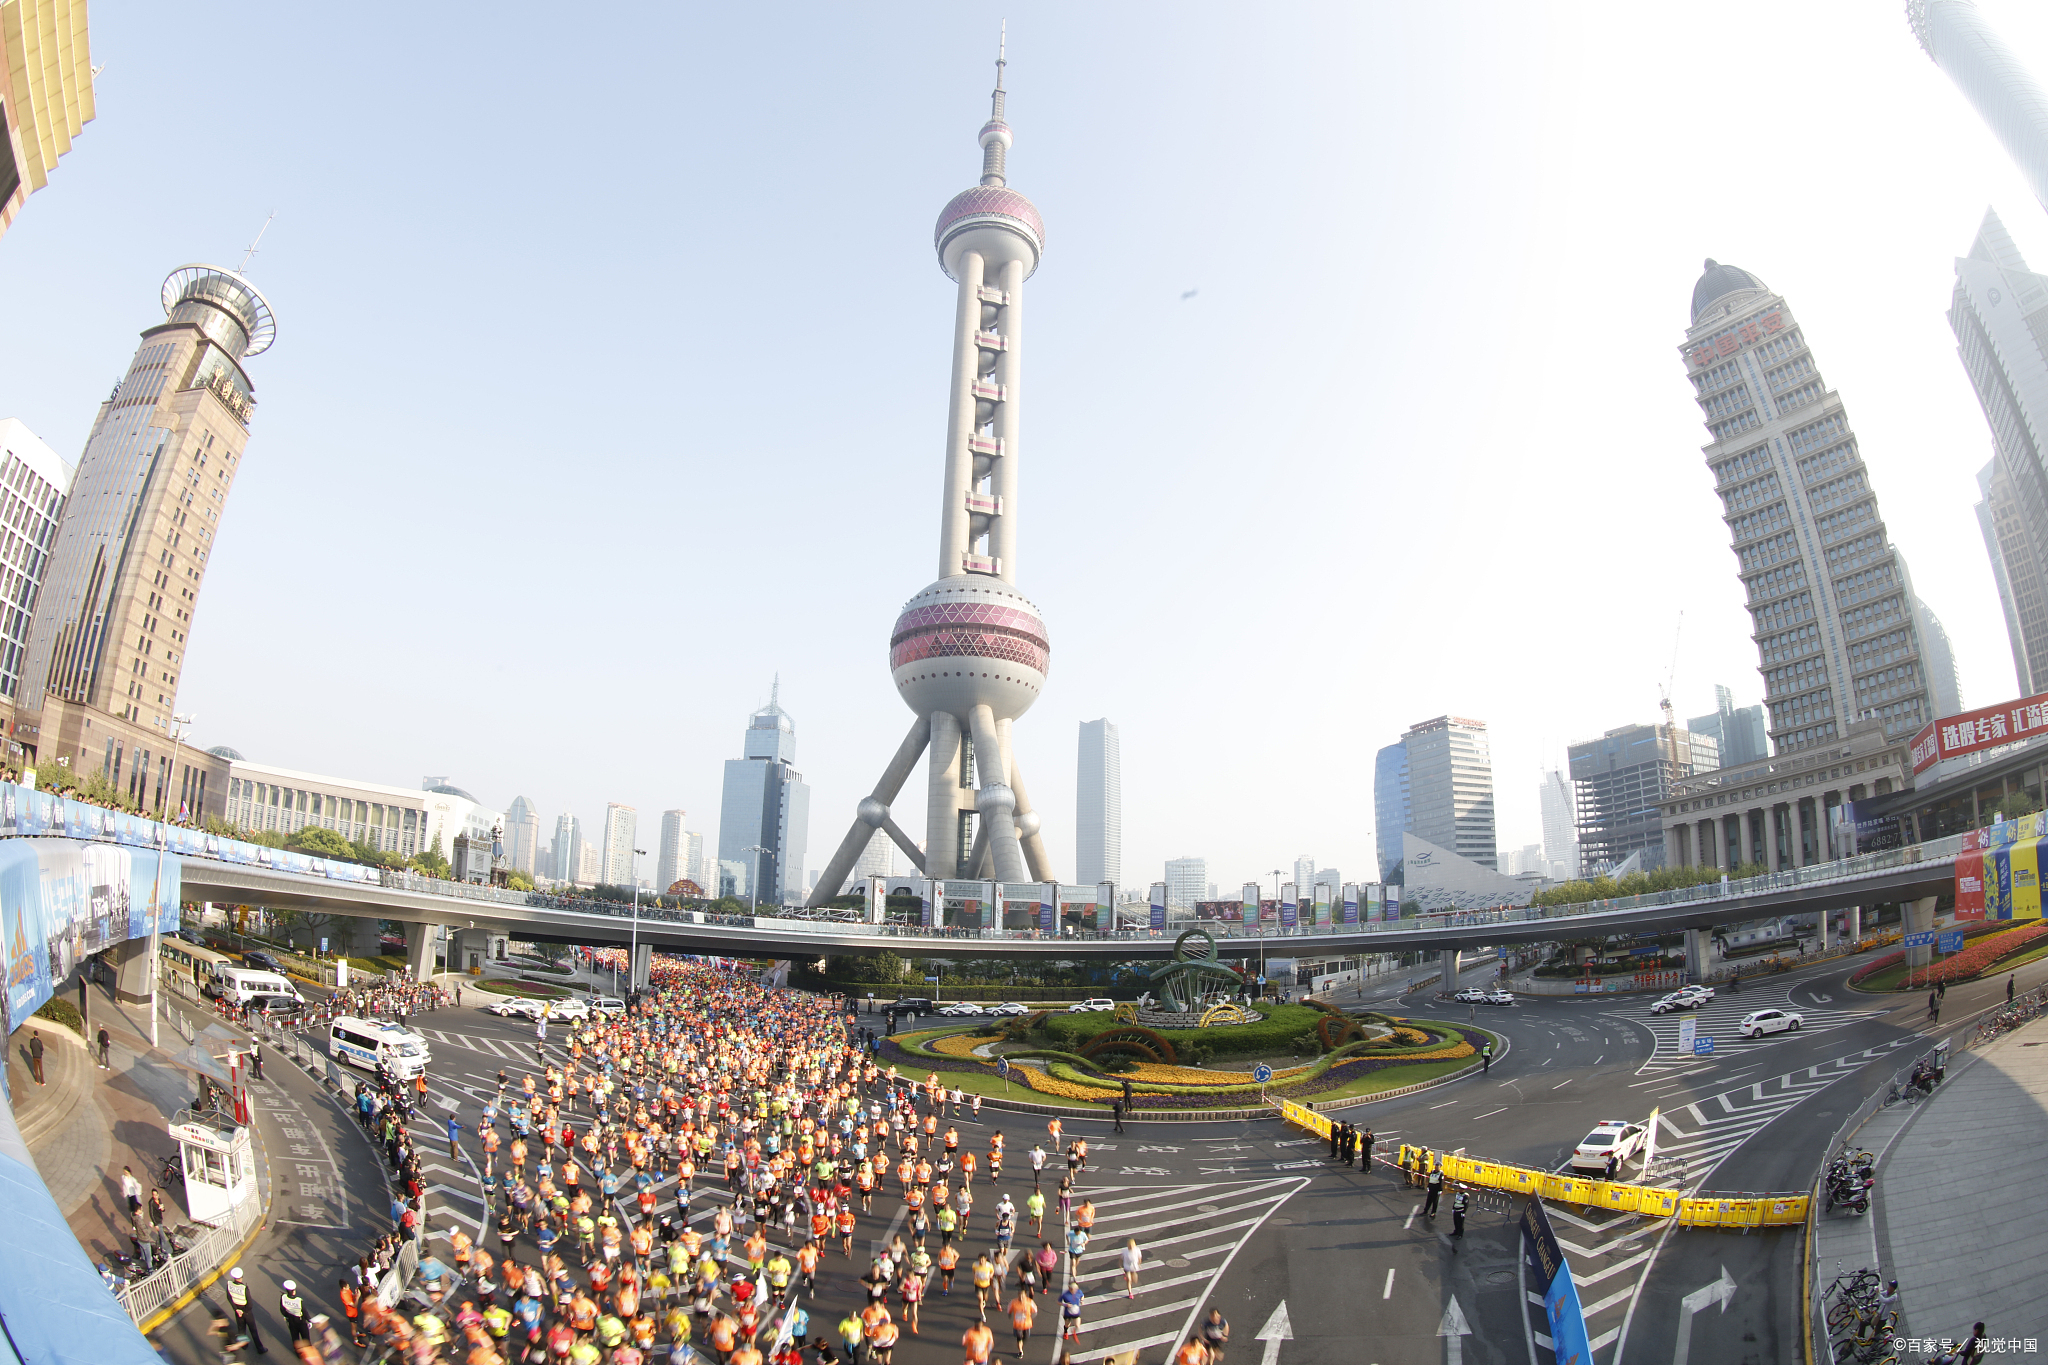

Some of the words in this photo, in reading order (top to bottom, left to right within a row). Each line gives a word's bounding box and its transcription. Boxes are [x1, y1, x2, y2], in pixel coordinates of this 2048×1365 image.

[1942, 714, 2008, 751] 选股专家
[1871, 834, 1892, 847] 6882
[10, 954, 34, 988] adidas
[229, 1285, 243, 1295] POLICE
[284, 1300, 299, 1308] POLICE
